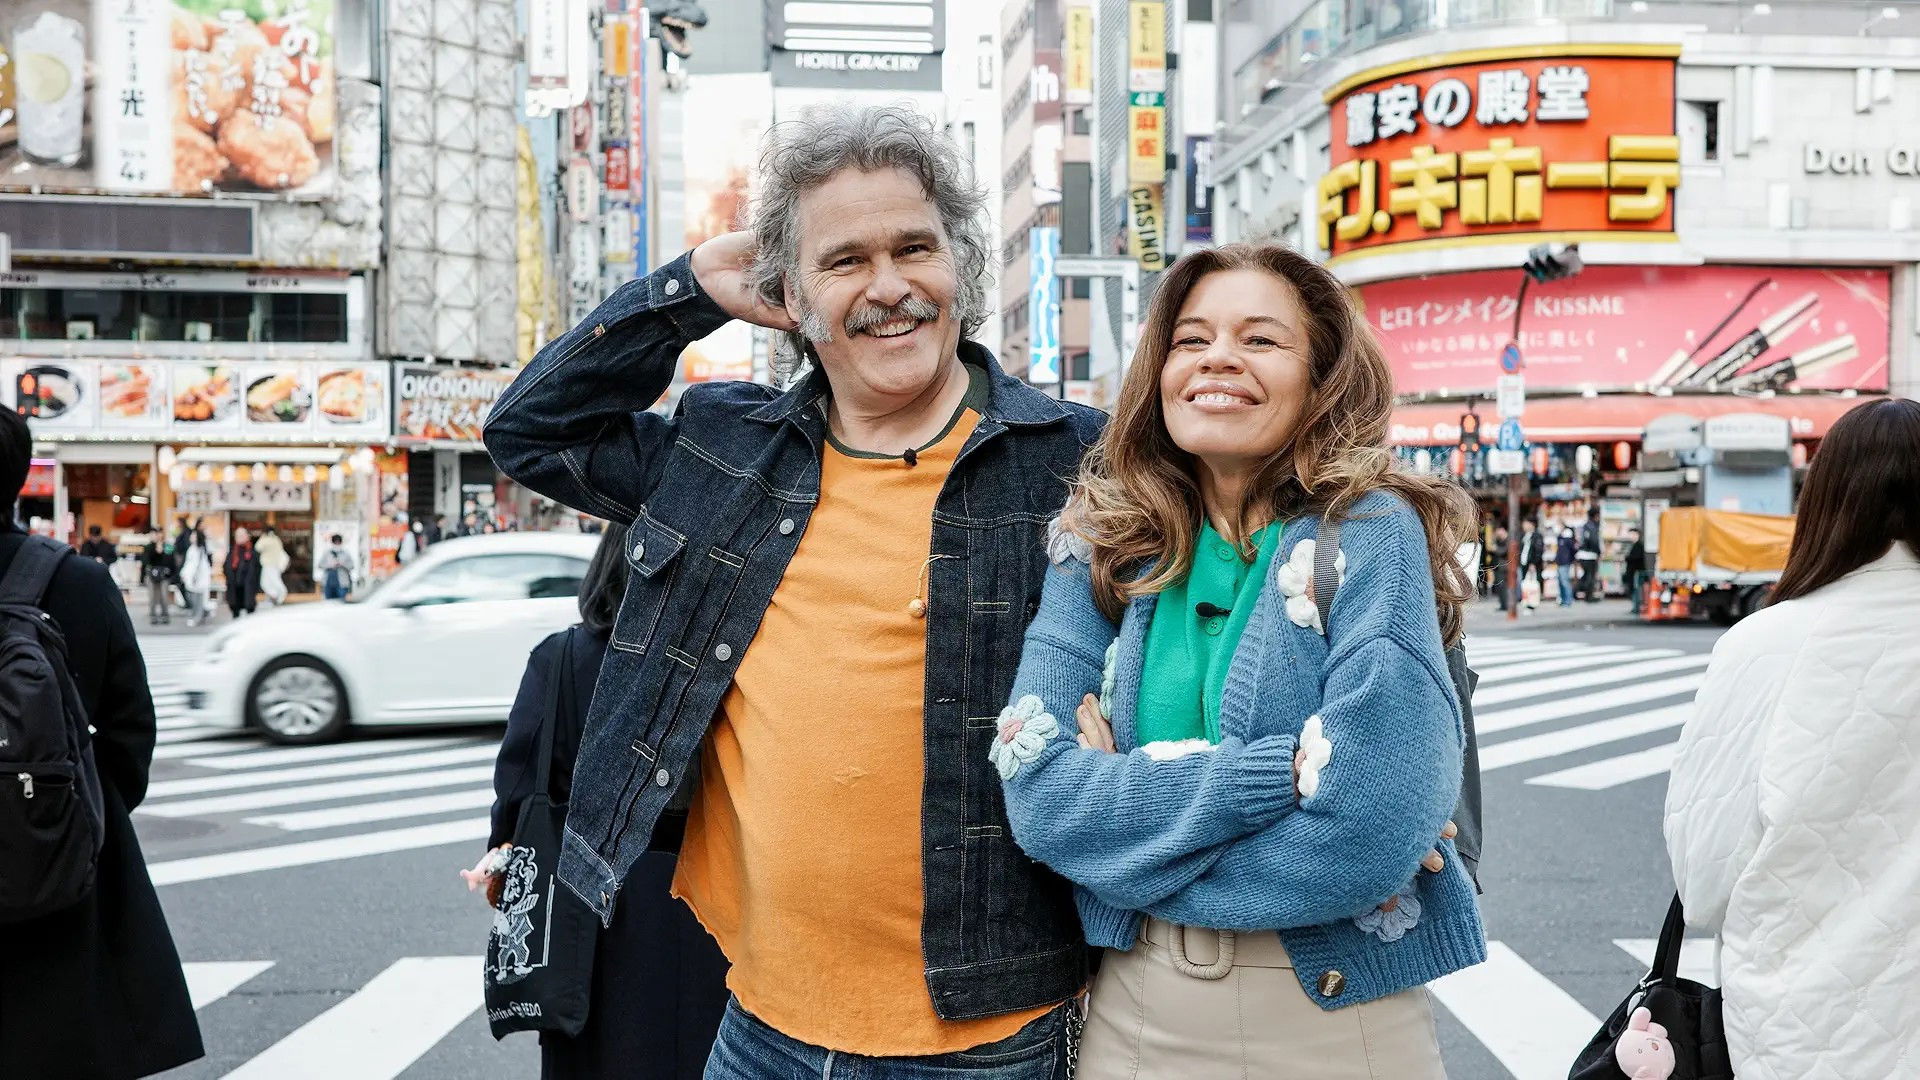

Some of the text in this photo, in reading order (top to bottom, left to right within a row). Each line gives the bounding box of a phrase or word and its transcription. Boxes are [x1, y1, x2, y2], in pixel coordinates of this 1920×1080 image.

[795, 52, 922, 72] HOTEL GRACERY
[1346, 67, 1590, 146] 驚安の殿堂
[1804, 144, 1871, 174] Don
[1131, 187, 1162, 263] CASINO
[1379, 295, 1519, 330] ヒロインメイク
[1534, 296, 1625, 317] KISSME
